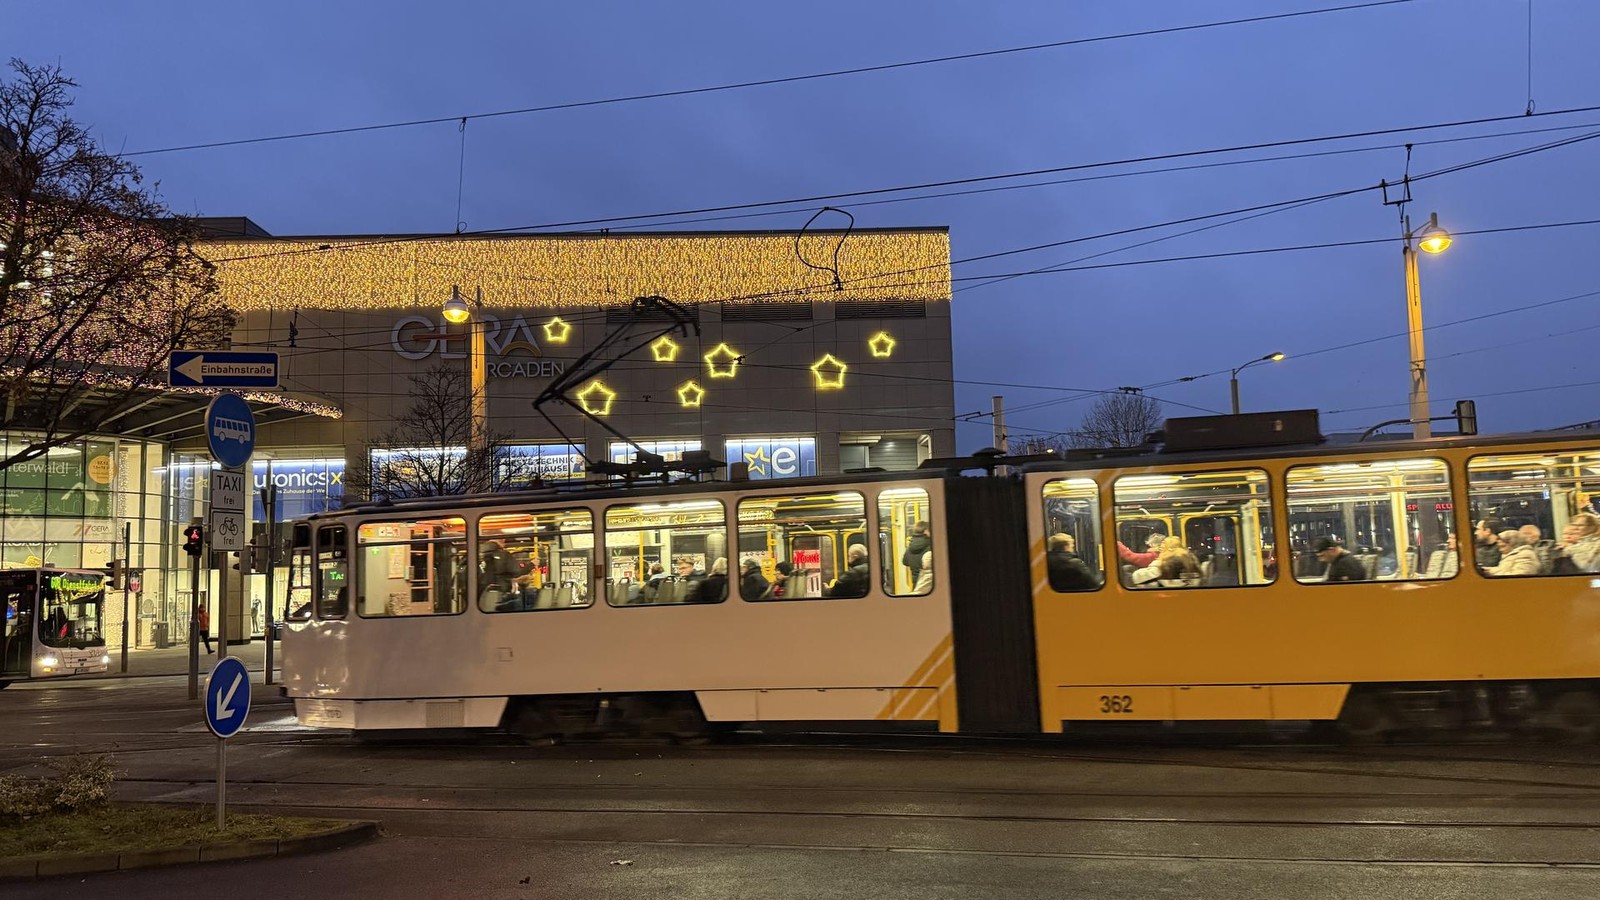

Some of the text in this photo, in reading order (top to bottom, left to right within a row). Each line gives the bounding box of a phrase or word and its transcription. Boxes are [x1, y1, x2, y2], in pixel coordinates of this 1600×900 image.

[201, 364, 272, 375] Einbahnstraße
[486, 361, 565, 378] RCADEN
[8, 461, 69, 474] terwald!
[216, 474, 242, 492] TAXI
[223, 494, 235, 505] frei
[223, 535, 235, 546] frei
[1100, 695, 1133, 713] 362
